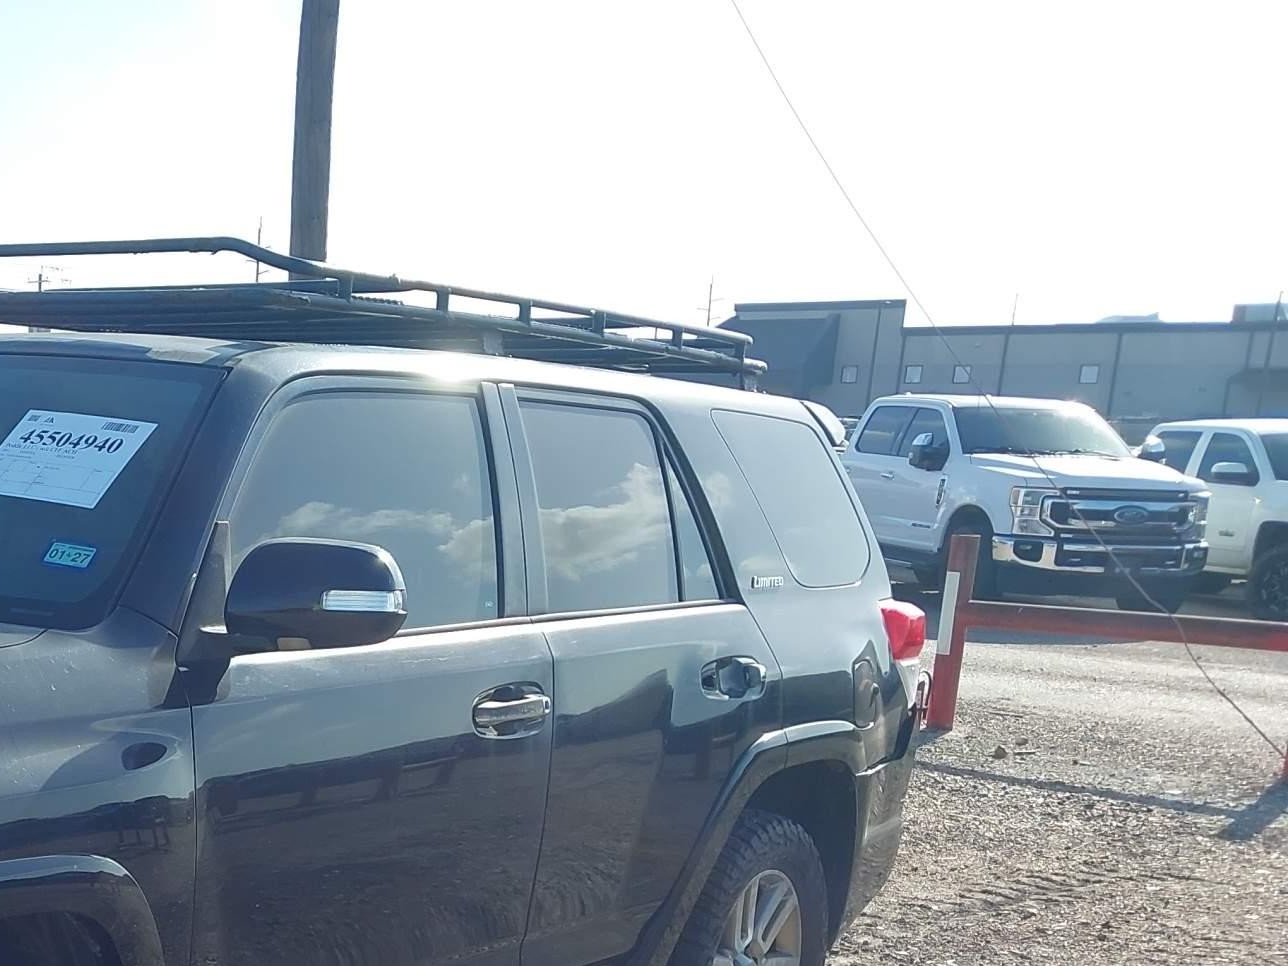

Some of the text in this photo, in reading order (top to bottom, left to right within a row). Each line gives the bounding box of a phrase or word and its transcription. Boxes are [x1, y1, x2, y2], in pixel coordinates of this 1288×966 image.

[19, 428, 124, 454] 45504940
[48, 548, 66, 560] 01
[70, 552, 91, 564] 27
